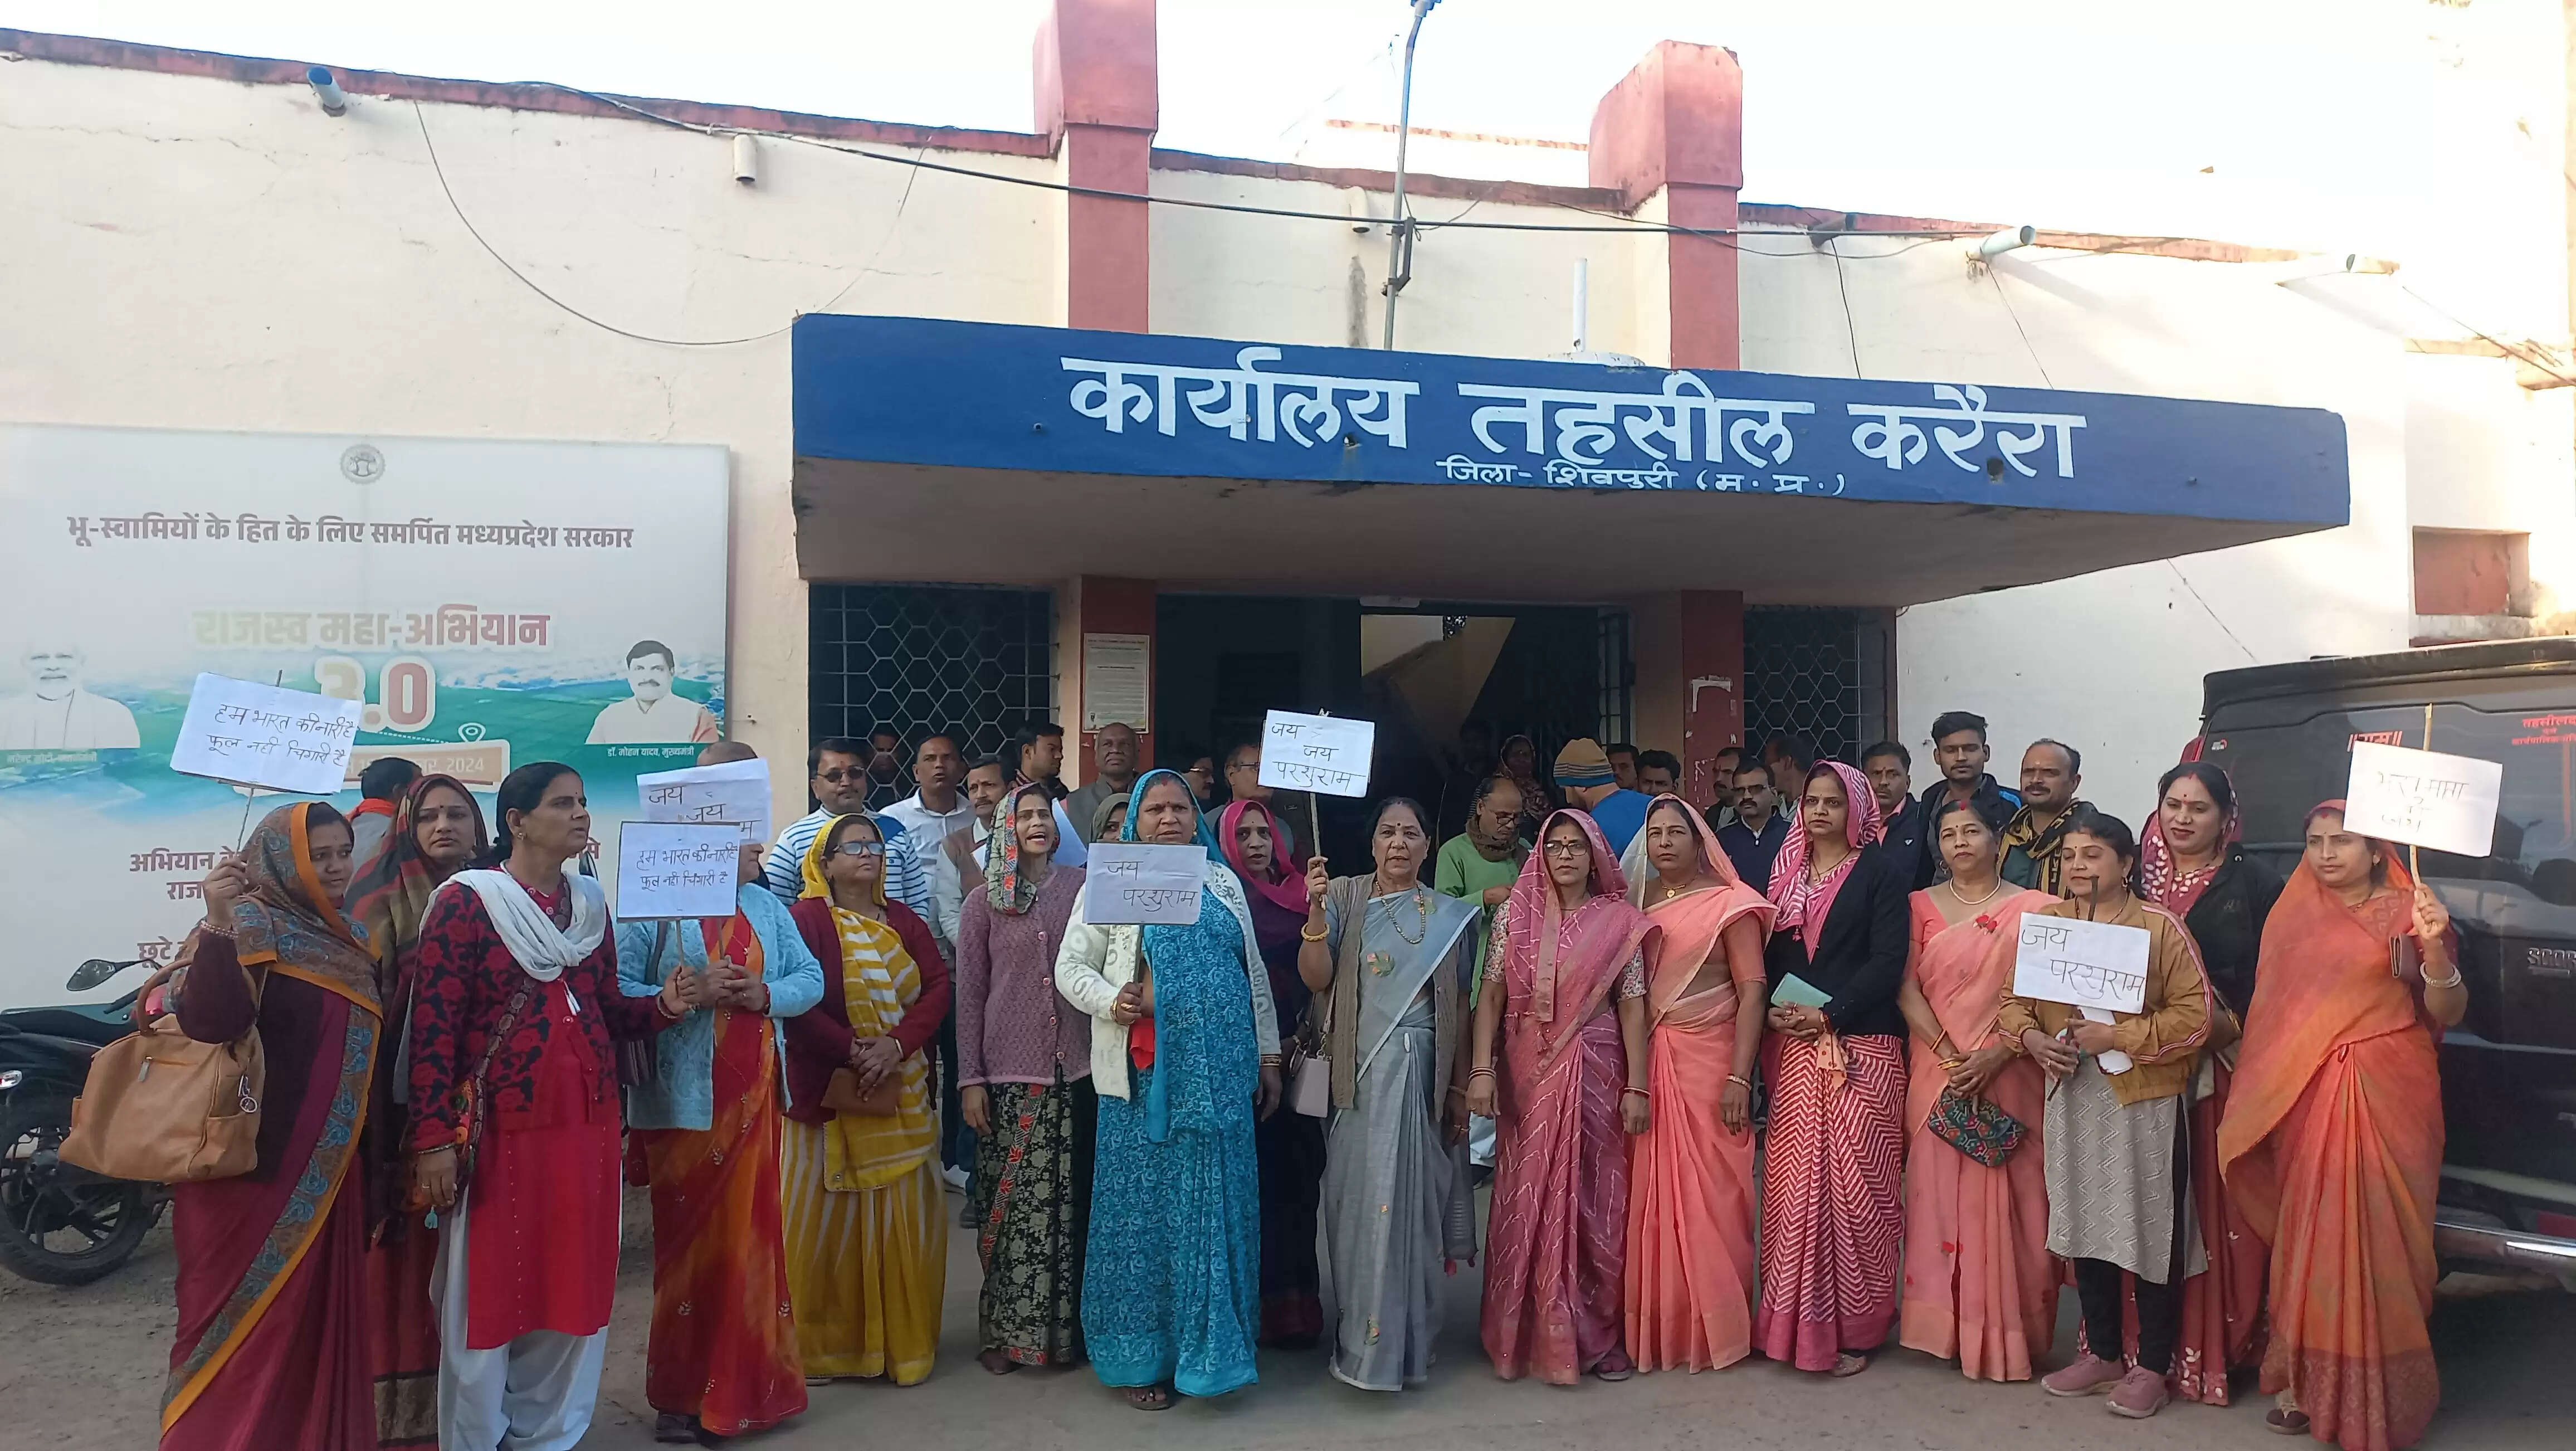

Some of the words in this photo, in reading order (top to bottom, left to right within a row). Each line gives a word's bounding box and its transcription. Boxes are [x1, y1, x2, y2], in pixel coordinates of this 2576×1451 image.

[1060, 346, 1421, 449] कार्यालय
[1457, 370, 1816, 469] तहसील
[1846, 384, 2087, 478] करैरा
[1543, 461, 1678, 489] शिवपुरी
[67, 512, 199, 547] भू-स्वामियों
[204, 513, 231, 539] के
[236, 513, 282, 543] हित
[285, 515, 311, 541] के
[316, 515, 365, 542] लिए
[370, 518, 451, 544] समर्पित
[456, 519, 558, 548] मध्यप्रदेश
[563, 528, 633, 548] सरकार
[191, 611, 311, 645] राजस्व
[317, 603, 550, 646] महा-अभियान
[214, 704, 251, 725] हम
[252, 710, 292, 733] भारत
[1272, 723, 1306, 739] जय
[206, 734, 243, 756] फूल
[618, 747, 639, 757] मोहन
[1304, 745, 1339, 761] जय
[446, 758, 484, 773] 2024
[1272, 762, 1366, 792] परशुराम
[649, 786, 686, 805] जय
[686, 804, 726, 821] जय
[130, 848, 215, 871] अभियान
[637, 850, 657, 870] हम
[662, 849, 690, 865] भारत
[1103, 861, 1144, 880] जय
[167, 881, 204, 899] राज
[640, 875, 661, 892] फूल
[1123, 889, 1198, 912] परशुराम
[2022, 924, 2072, 951] जय
